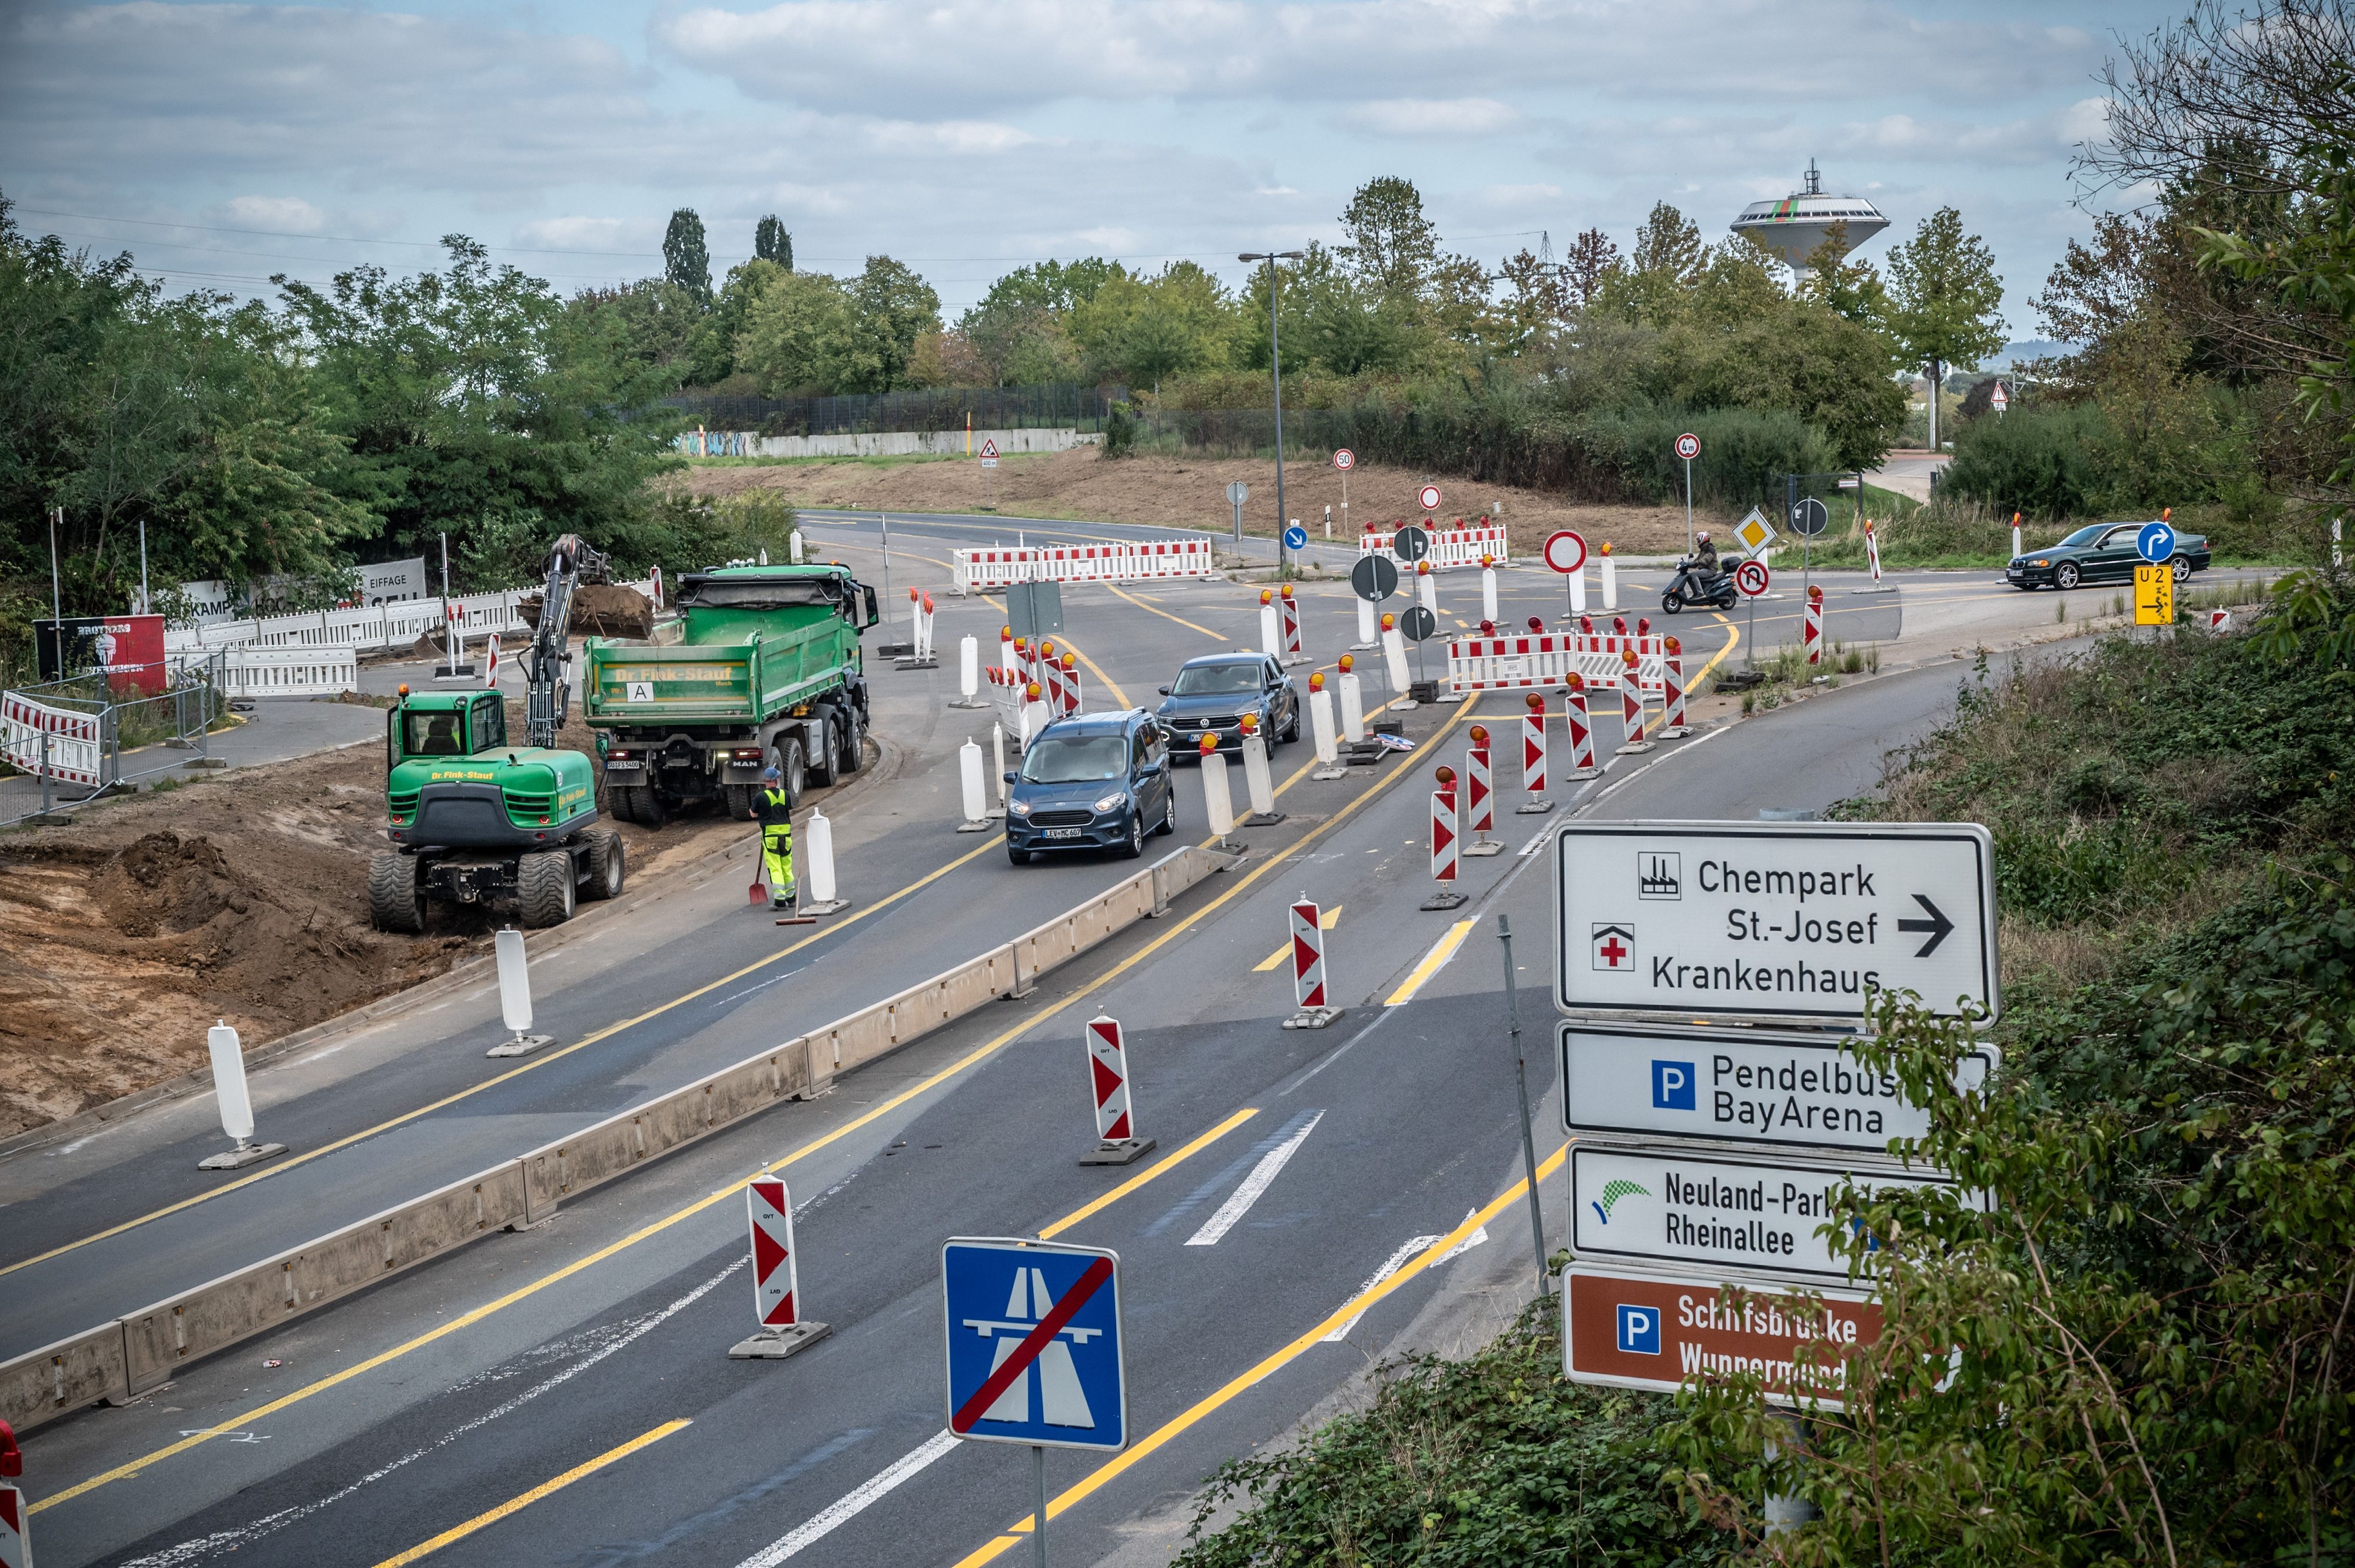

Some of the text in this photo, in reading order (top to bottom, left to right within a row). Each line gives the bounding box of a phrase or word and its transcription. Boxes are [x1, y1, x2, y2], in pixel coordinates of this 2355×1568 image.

[1338, 454, 1350, 464] 50
[1682, 441, 1687, 451] 4
[370, 575, 407, 588] EIFFAGE
[2140, 568, 2164, 583] U 2
[641, 667, 732, 682] Fink-Stauf
[634, 685, 647, 699] A
[432, 771, 493, 780] Dr. Fink-Stauf
[1699, 860, 1876, 903] Chempark
[1727, 908, 1878, 944] St.-Josef
[1653, 956, 1881, 995] Krankenhaus
[1662, 1055, 1896, 1102] P Pendelbus
[1714, 1090, 1883, 1134] BayArena
[1665, 1172, 1834, 1218] Neuland-Park
[1666, 1212, 1795, 1255] Rheinallee
[1627, 1312, 1650, 1346] P
